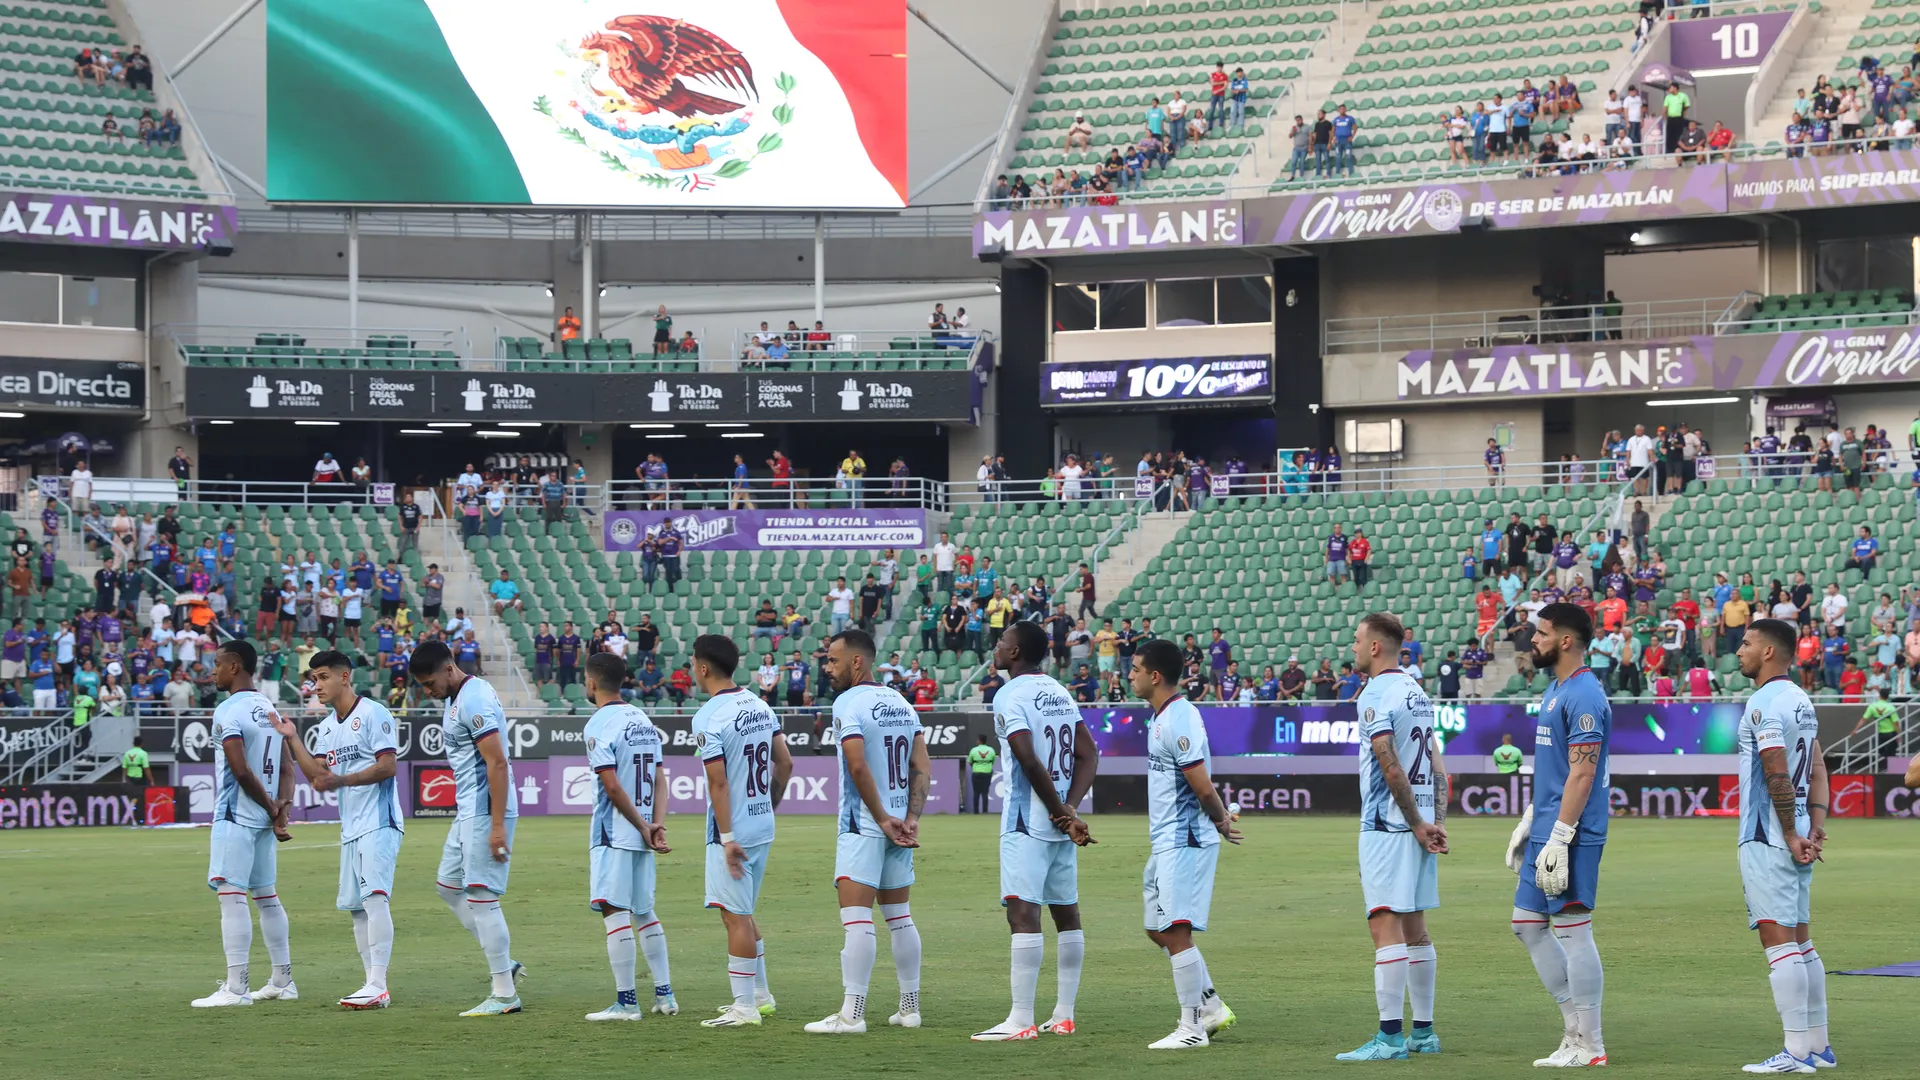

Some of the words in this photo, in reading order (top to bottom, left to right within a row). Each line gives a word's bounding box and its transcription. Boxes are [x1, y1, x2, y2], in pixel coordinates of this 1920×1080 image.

[1711, 22, 1759, 59] 10
[1344, 199, 1355, 207] EL
[1355, 194, 1392, 207] GRAN
[1733, 180, 1783, 197] NACIMOS
[1785, 177, 1815, 193] PARA
[1470, 201, 1496, 217] DE
[1499, 198, 1535, 215] SER
[1538, 197, 1564, 213] DE
[1567, 186, 1674, 211] MAZATLÁN
[984, 207, 1208, 250] MAZATLÁN
[1834, 339, 1846, 348] EL
[1846, 335, 1885, 348] GRAN
[38, 371, 131, 398] Directa
[1127, 363, 1213, 397] 10%
[1398, 349, 1649, 396] MAZATLÁN
[369, 383, 415, 391] CORONAS
[758, 385, 803, 393] CORONAS
[758, 400, 766, 408] A
[768, 400, 792, 408] CASA
[688, 518, 727, 544] SHOP
[765, 517, 815, 526] TIENDA
[818, 517, 869, 526] OFICIAL
[766, 533, 915, 542] TIENDA.MAZATLANFC.COM
[1275, 716, 1296, 744] En
[263, 736, 273, 785] 4
[884, 735, 909, 791] 10
[1044, 723, 1075, 781] 28
[633, 753, 653, 807] 15
[743, 741, 770, 798] 18
[415, 808, 457, 817] caliente.m
